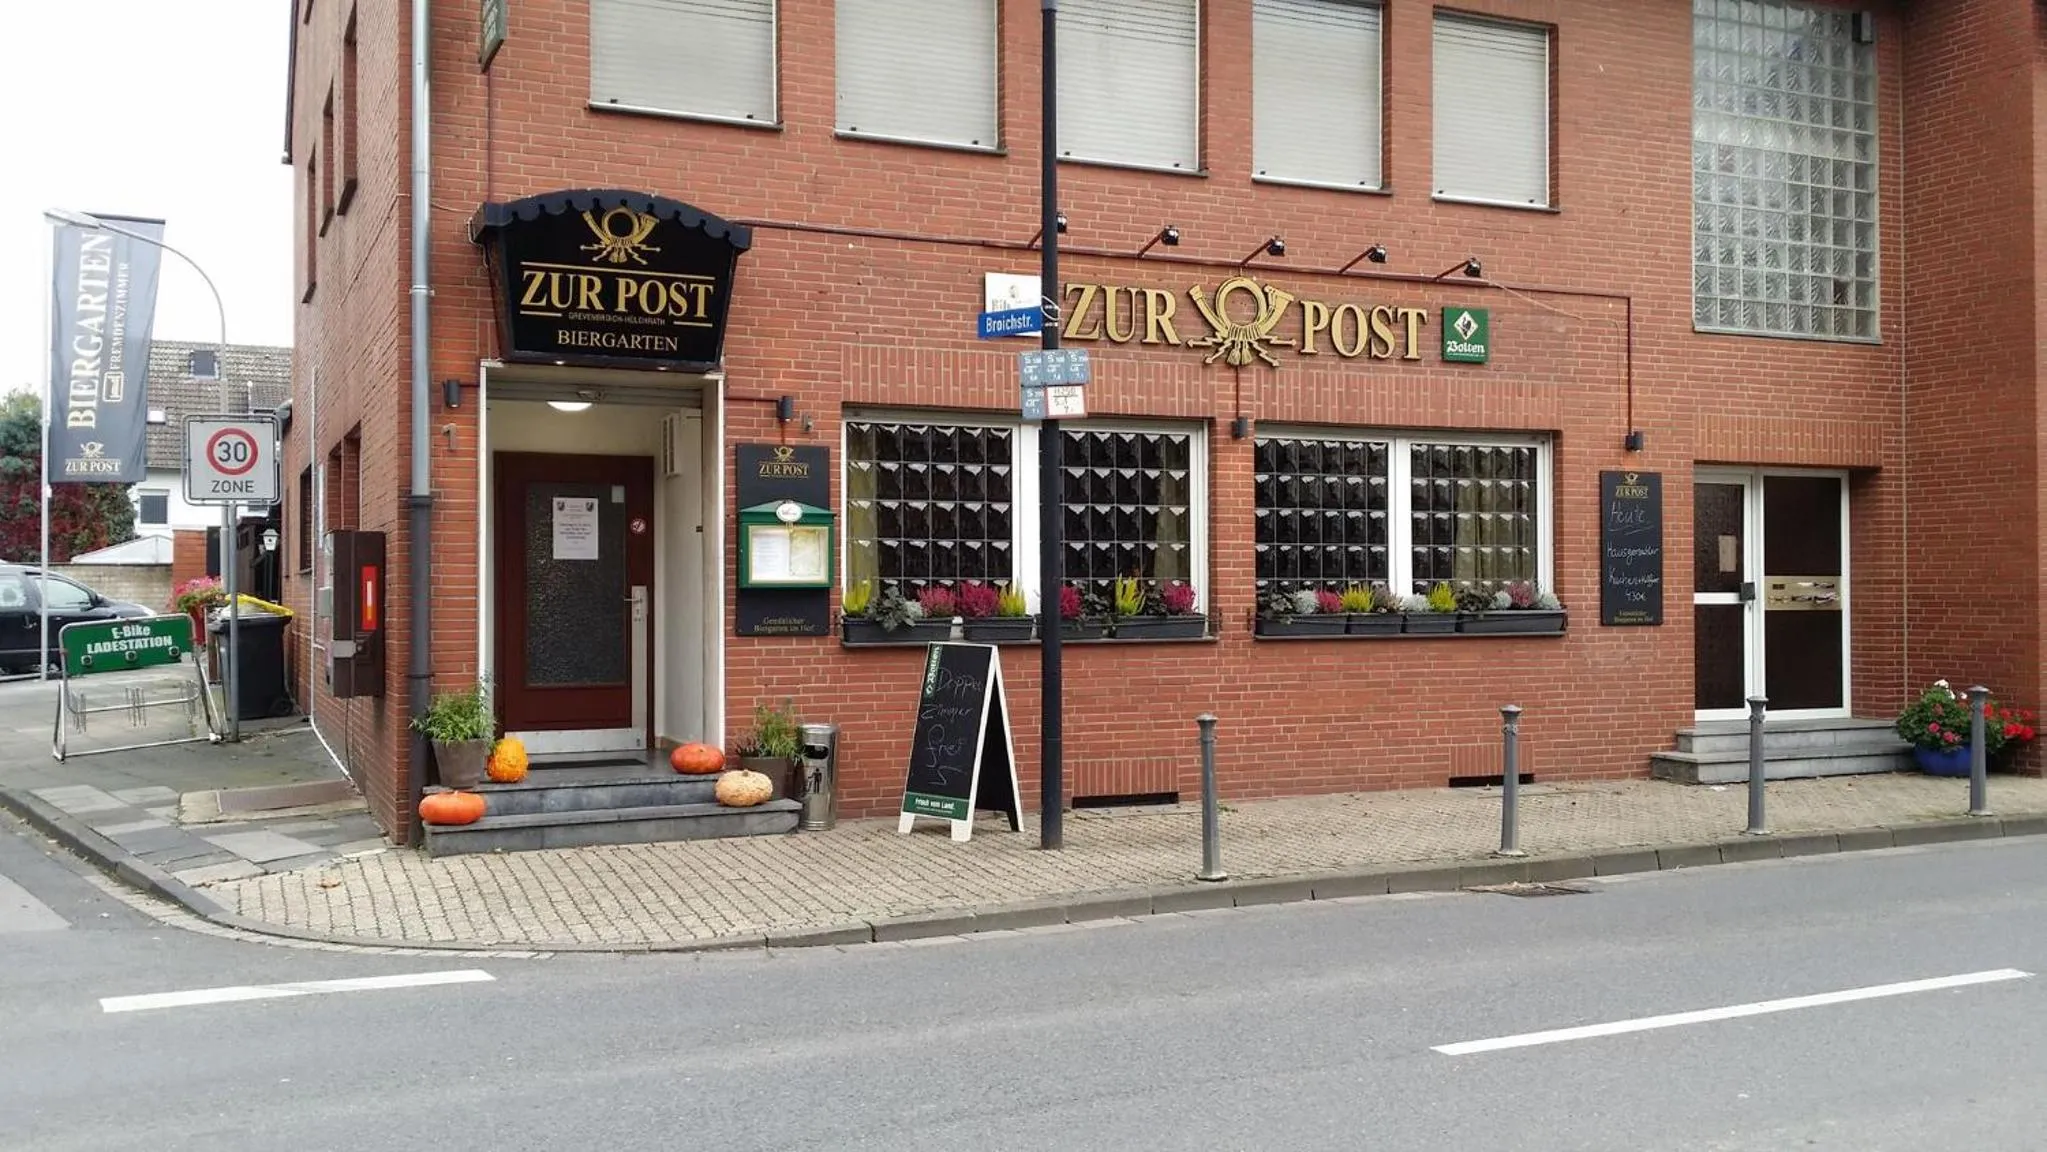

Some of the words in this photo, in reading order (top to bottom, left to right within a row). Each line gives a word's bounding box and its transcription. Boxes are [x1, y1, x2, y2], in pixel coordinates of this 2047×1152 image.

[519, 270, 605, 312] ZUR
[614, 277, 715, 319] POST
[109, 262, 129, 371] FREMDENZIMMER
[986, 313, 1034, 333] Broichstr.
[1063, 282, 1181, 345] ZUR
[1299, 299, 1429, 360] POST
[67, 233, 113, 429] BIERGARTEN
[557, 330, 679, 351] BIERGARTEN
[1446, 340, 1486, 354] Bolten
[218, 441, 247, 462] 30
[66, 461, 88, 472] ZUR
[90, 461, 120, 473] POST
[760, 464, 781, 475] ZUR
[782, 464, 810, 476] POST
[211, 480, 255, 493] ZONE
[111, 625, 151, 640] E-Bike
[86, 635, 173, 655] LADESTATION
